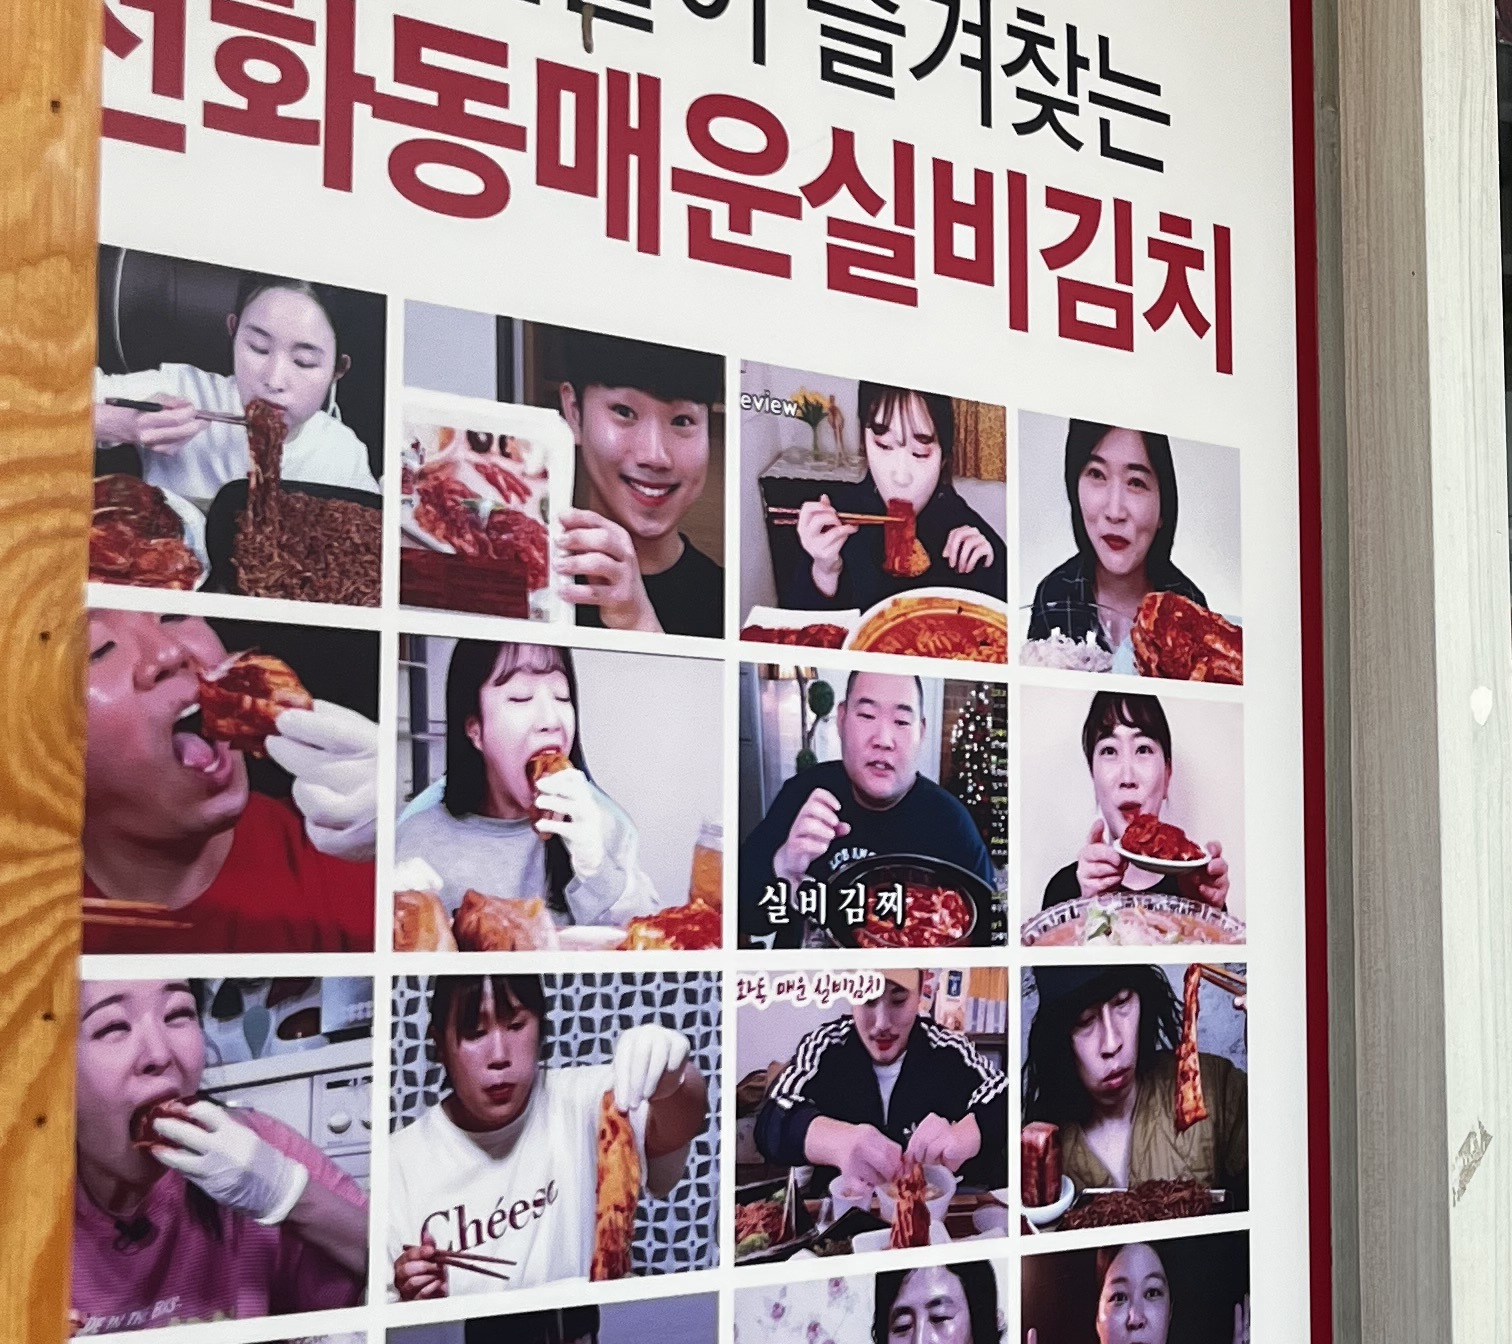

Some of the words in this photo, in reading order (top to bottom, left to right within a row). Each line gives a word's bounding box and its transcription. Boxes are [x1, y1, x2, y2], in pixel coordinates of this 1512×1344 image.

[740, 389, 799, 418] eview
[776, 976, 808, 1002] 매운
[814, 973, 882, 1005] 실비김치
